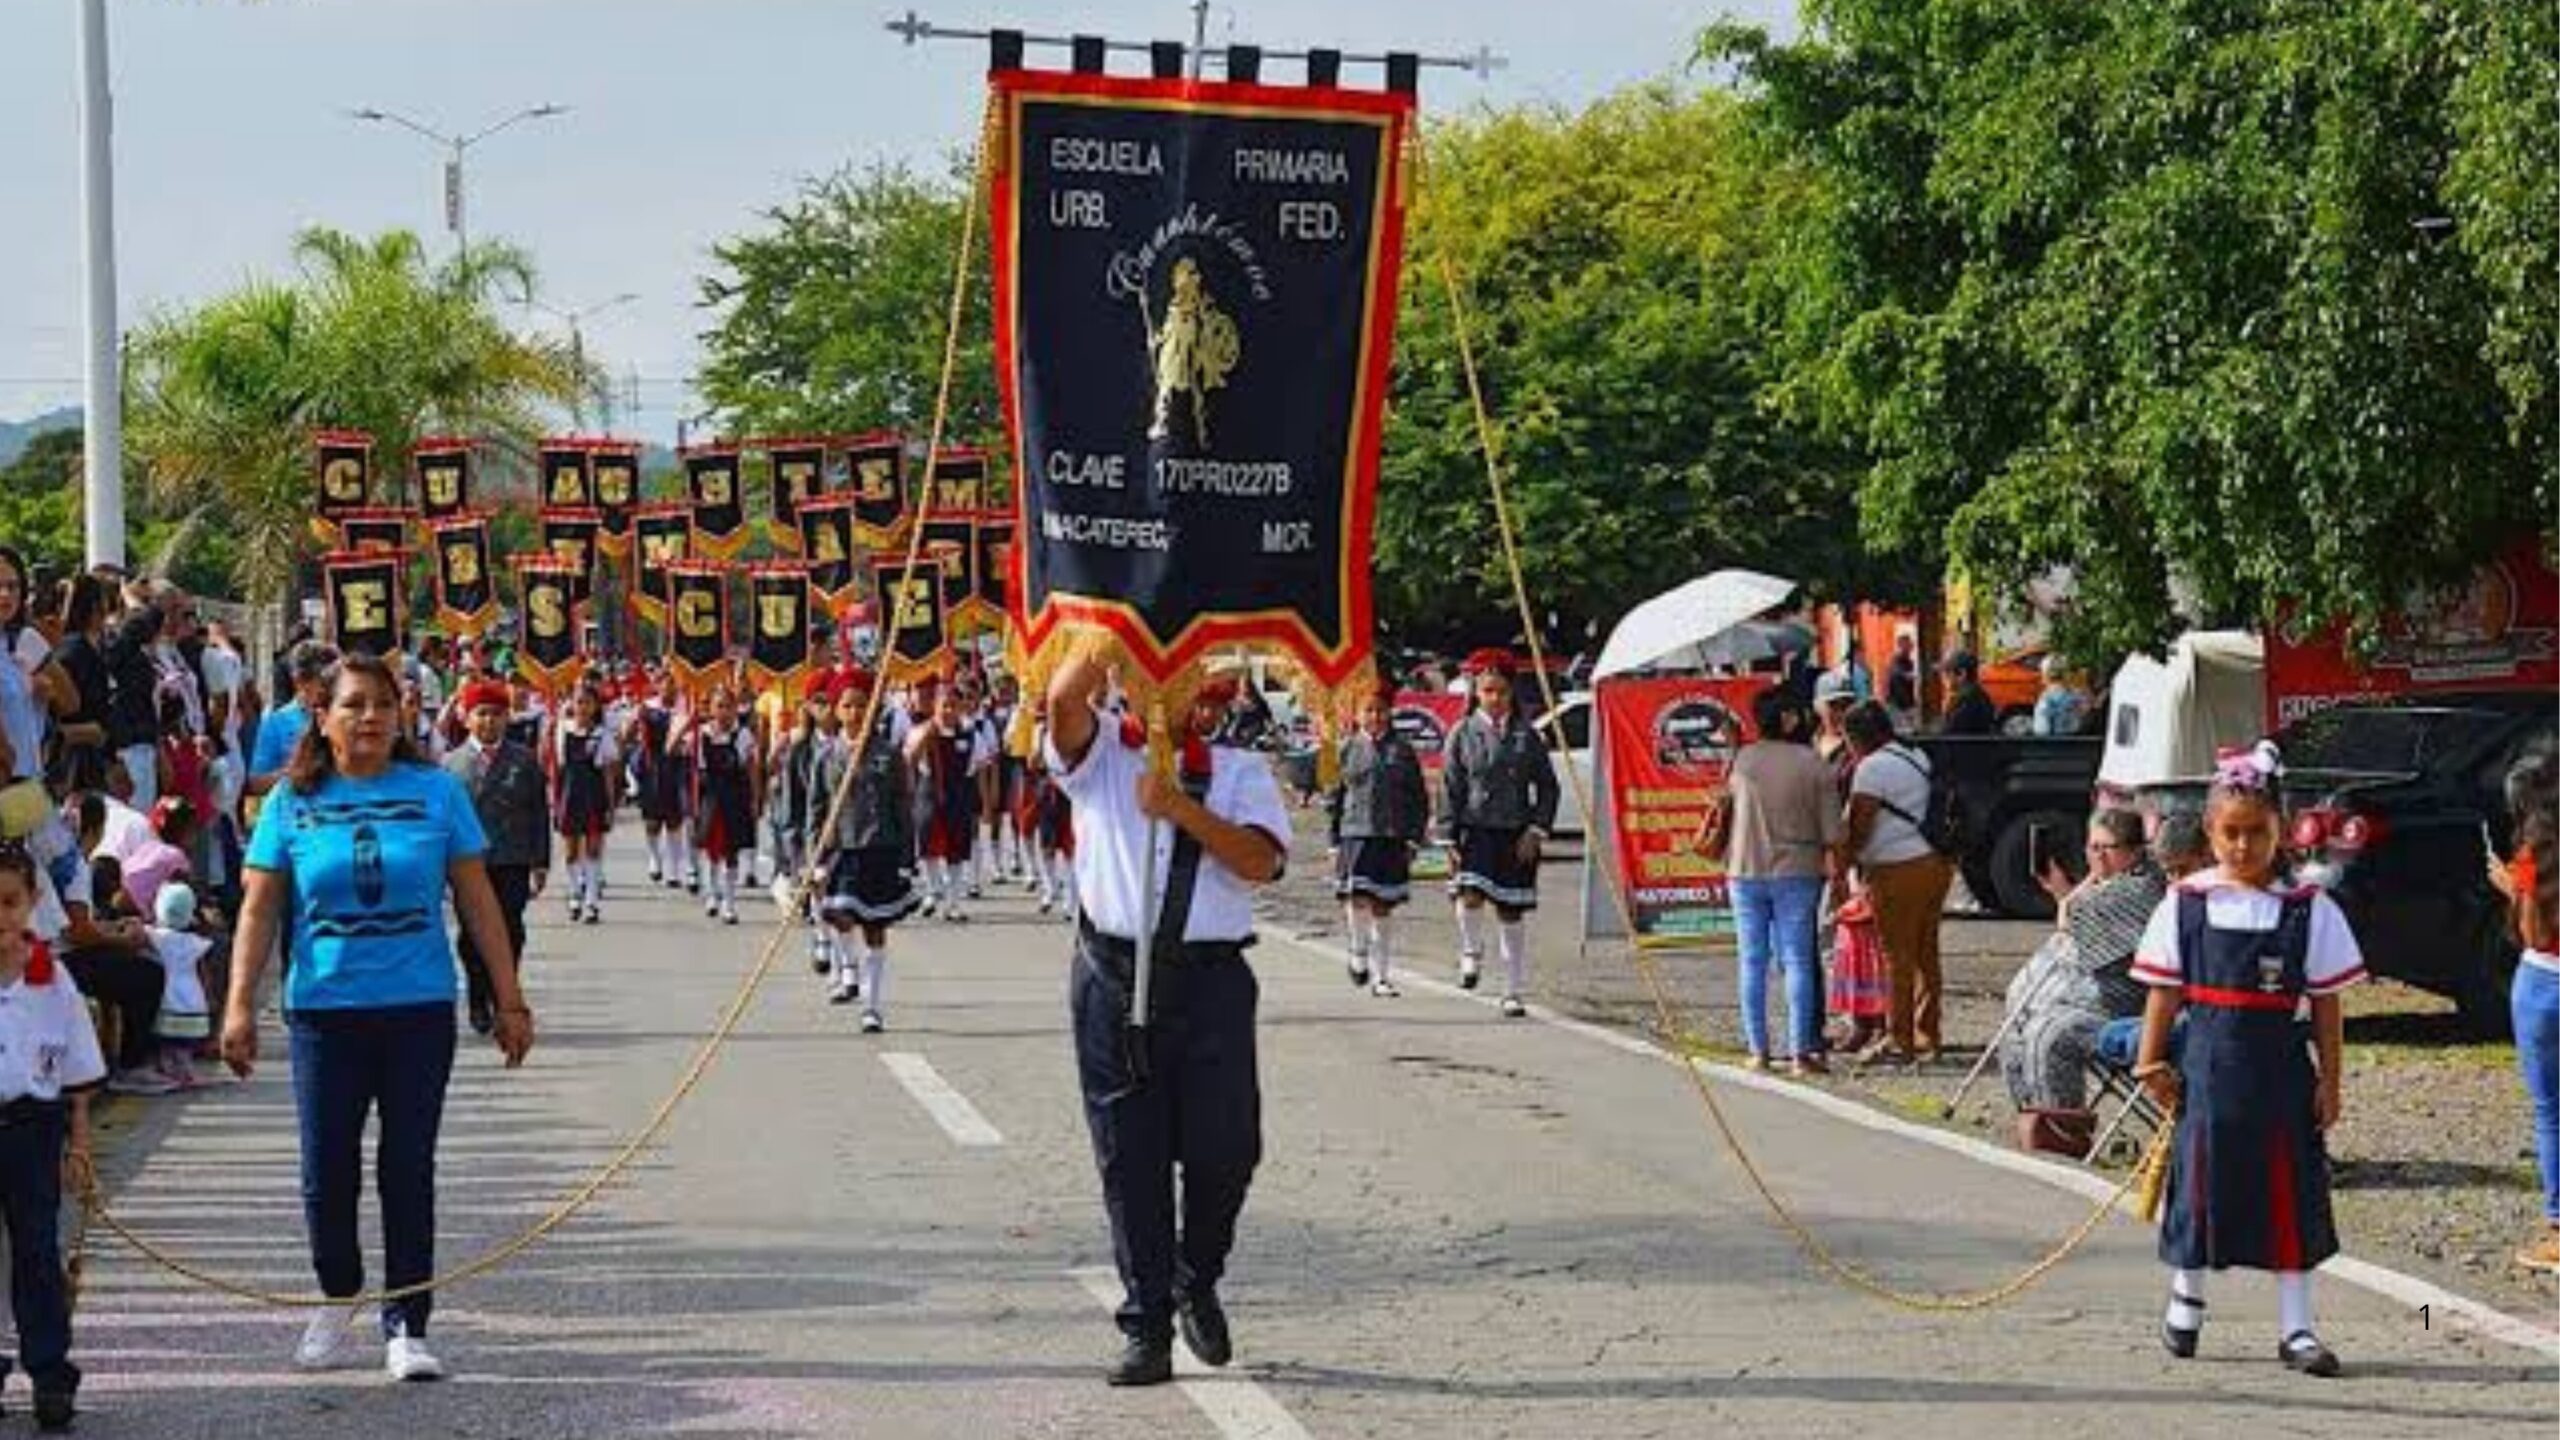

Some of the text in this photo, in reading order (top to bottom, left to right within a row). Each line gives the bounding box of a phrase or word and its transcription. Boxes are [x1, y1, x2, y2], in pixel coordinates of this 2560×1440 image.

[1051, 138, 1349, 184] ESCUELA PRIMARIA
[1050, 190, 1345, 240] URB. FED.
[325, 459, 363, 499] C
[424, 467, 459, 504] U
[858, 458, 894, 499] E
[1047, 450, 1125, 488] CLAVE
[340, 579, 933, 638] E S C U E
